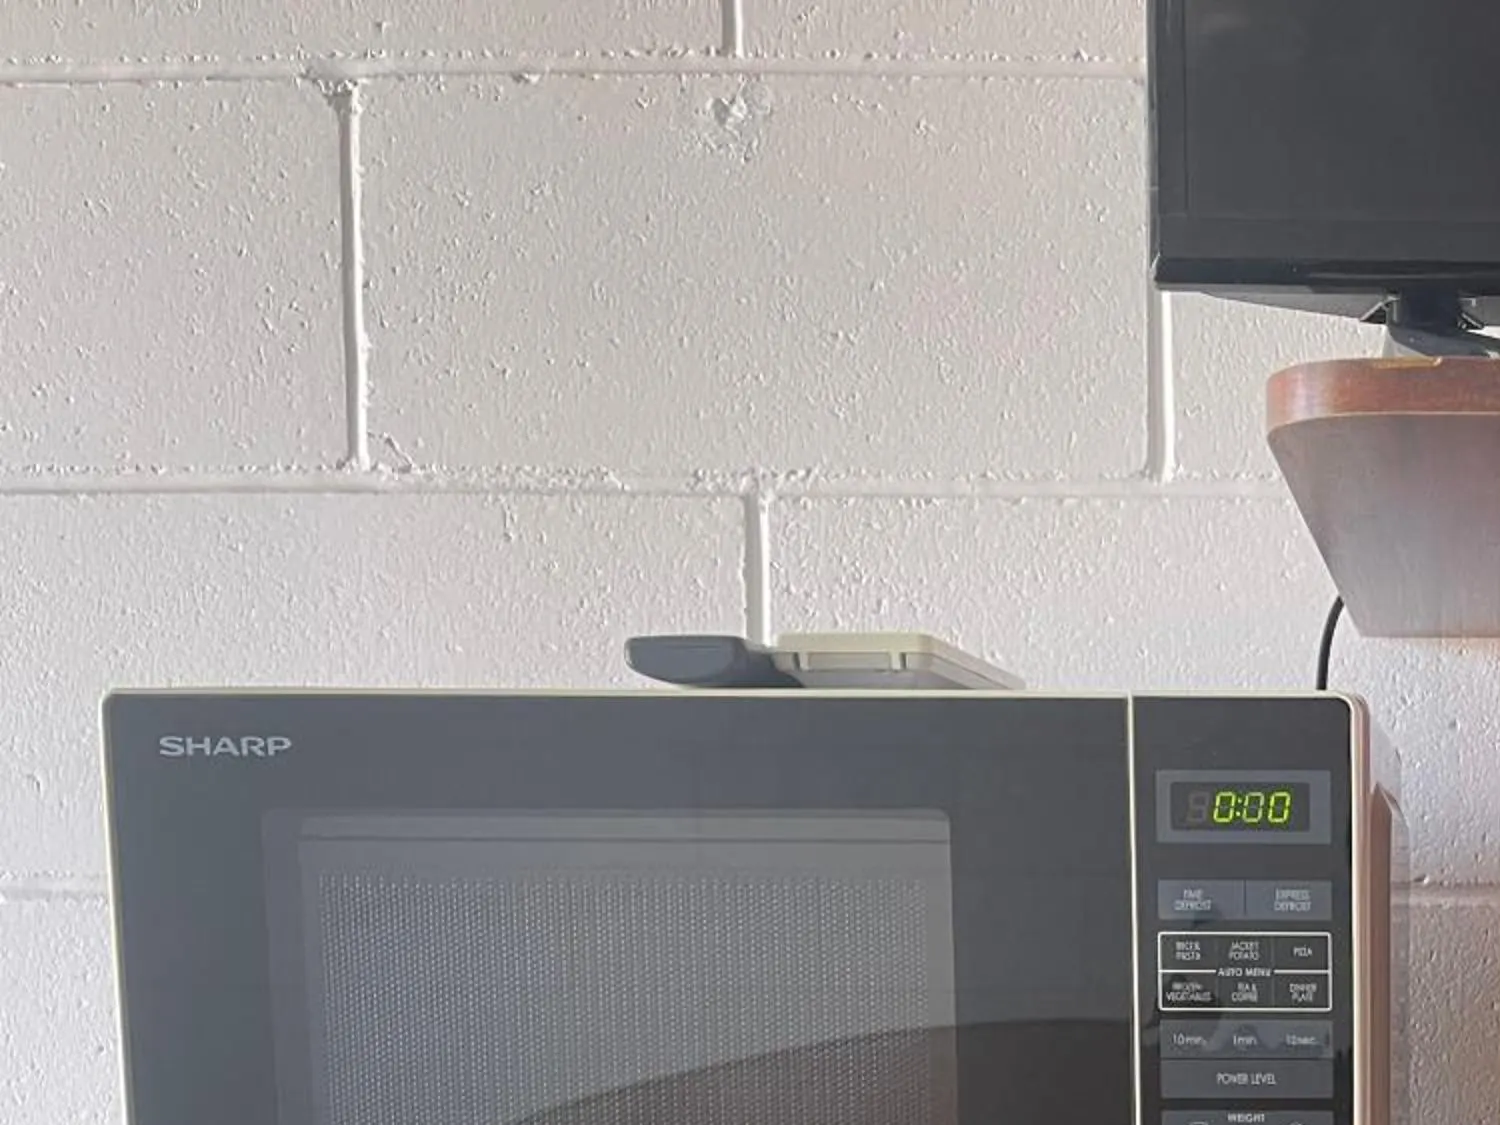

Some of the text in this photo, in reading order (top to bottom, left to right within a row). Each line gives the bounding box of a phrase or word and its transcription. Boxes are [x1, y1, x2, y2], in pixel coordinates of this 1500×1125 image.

[159, 735, 293, 758] SHARP
[1212, 790, 1293, 824] 0:00
[1174, 900, 1212, 912] DEFROST
[1274, 900, 1312, 912] DEFROST
[1228, 951, 1260, 961] POTATO
[1217, 967, 1272, 977] AUTO MENU
[1216, 1072, 1277, 1085] POWER LEVEL
[1227, 1113, 1265, 1123] WEIGHT
